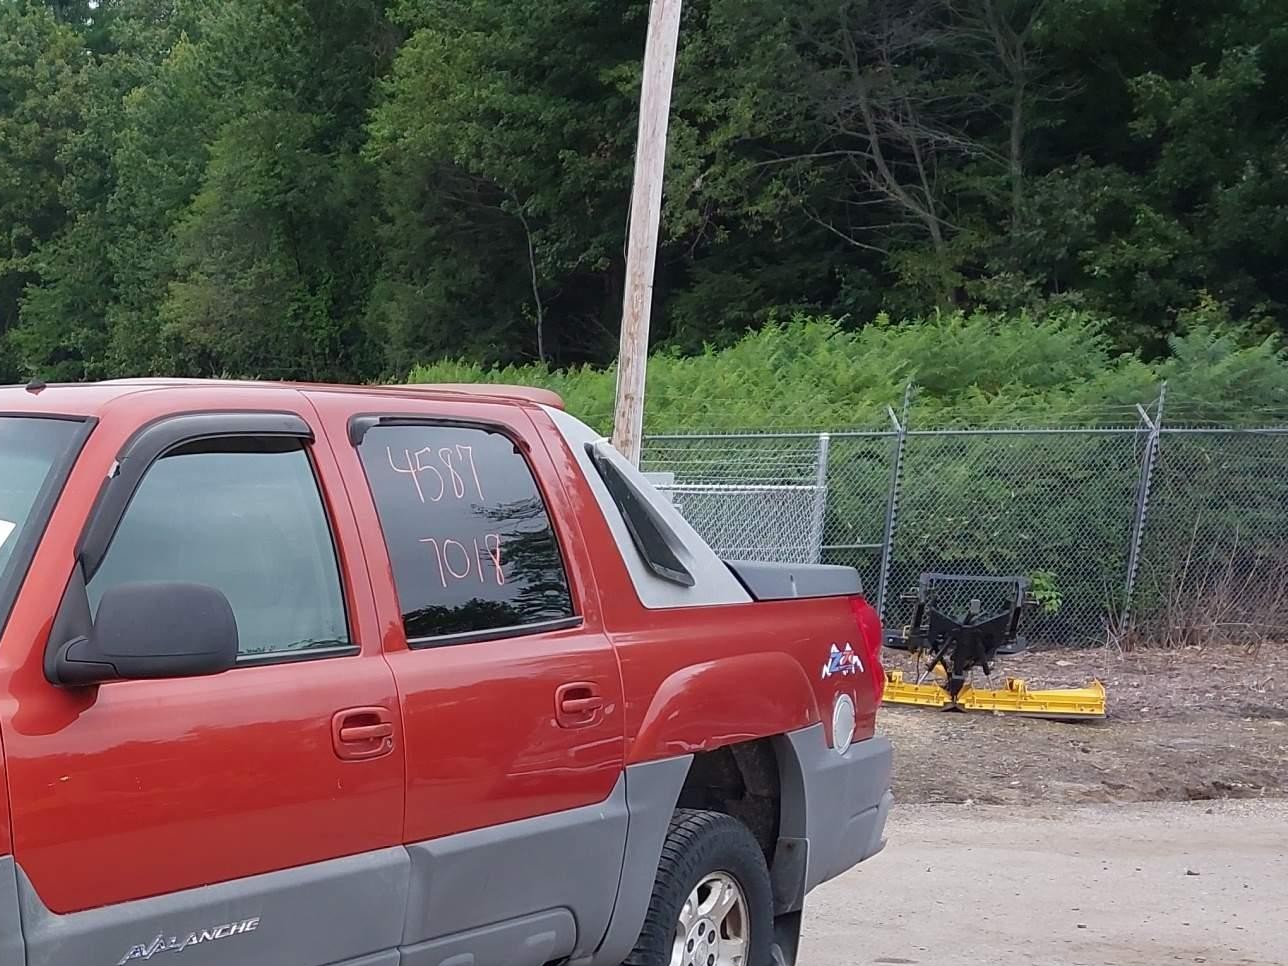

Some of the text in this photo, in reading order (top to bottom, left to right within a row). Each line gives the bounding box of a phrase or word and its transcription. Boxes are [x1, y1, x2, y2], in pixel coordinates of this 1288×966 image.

[386, 444, 485, 504] 4587
[419, 533, 505, 588] 7018
[116, 916, 261, 966] AVALANCHE
